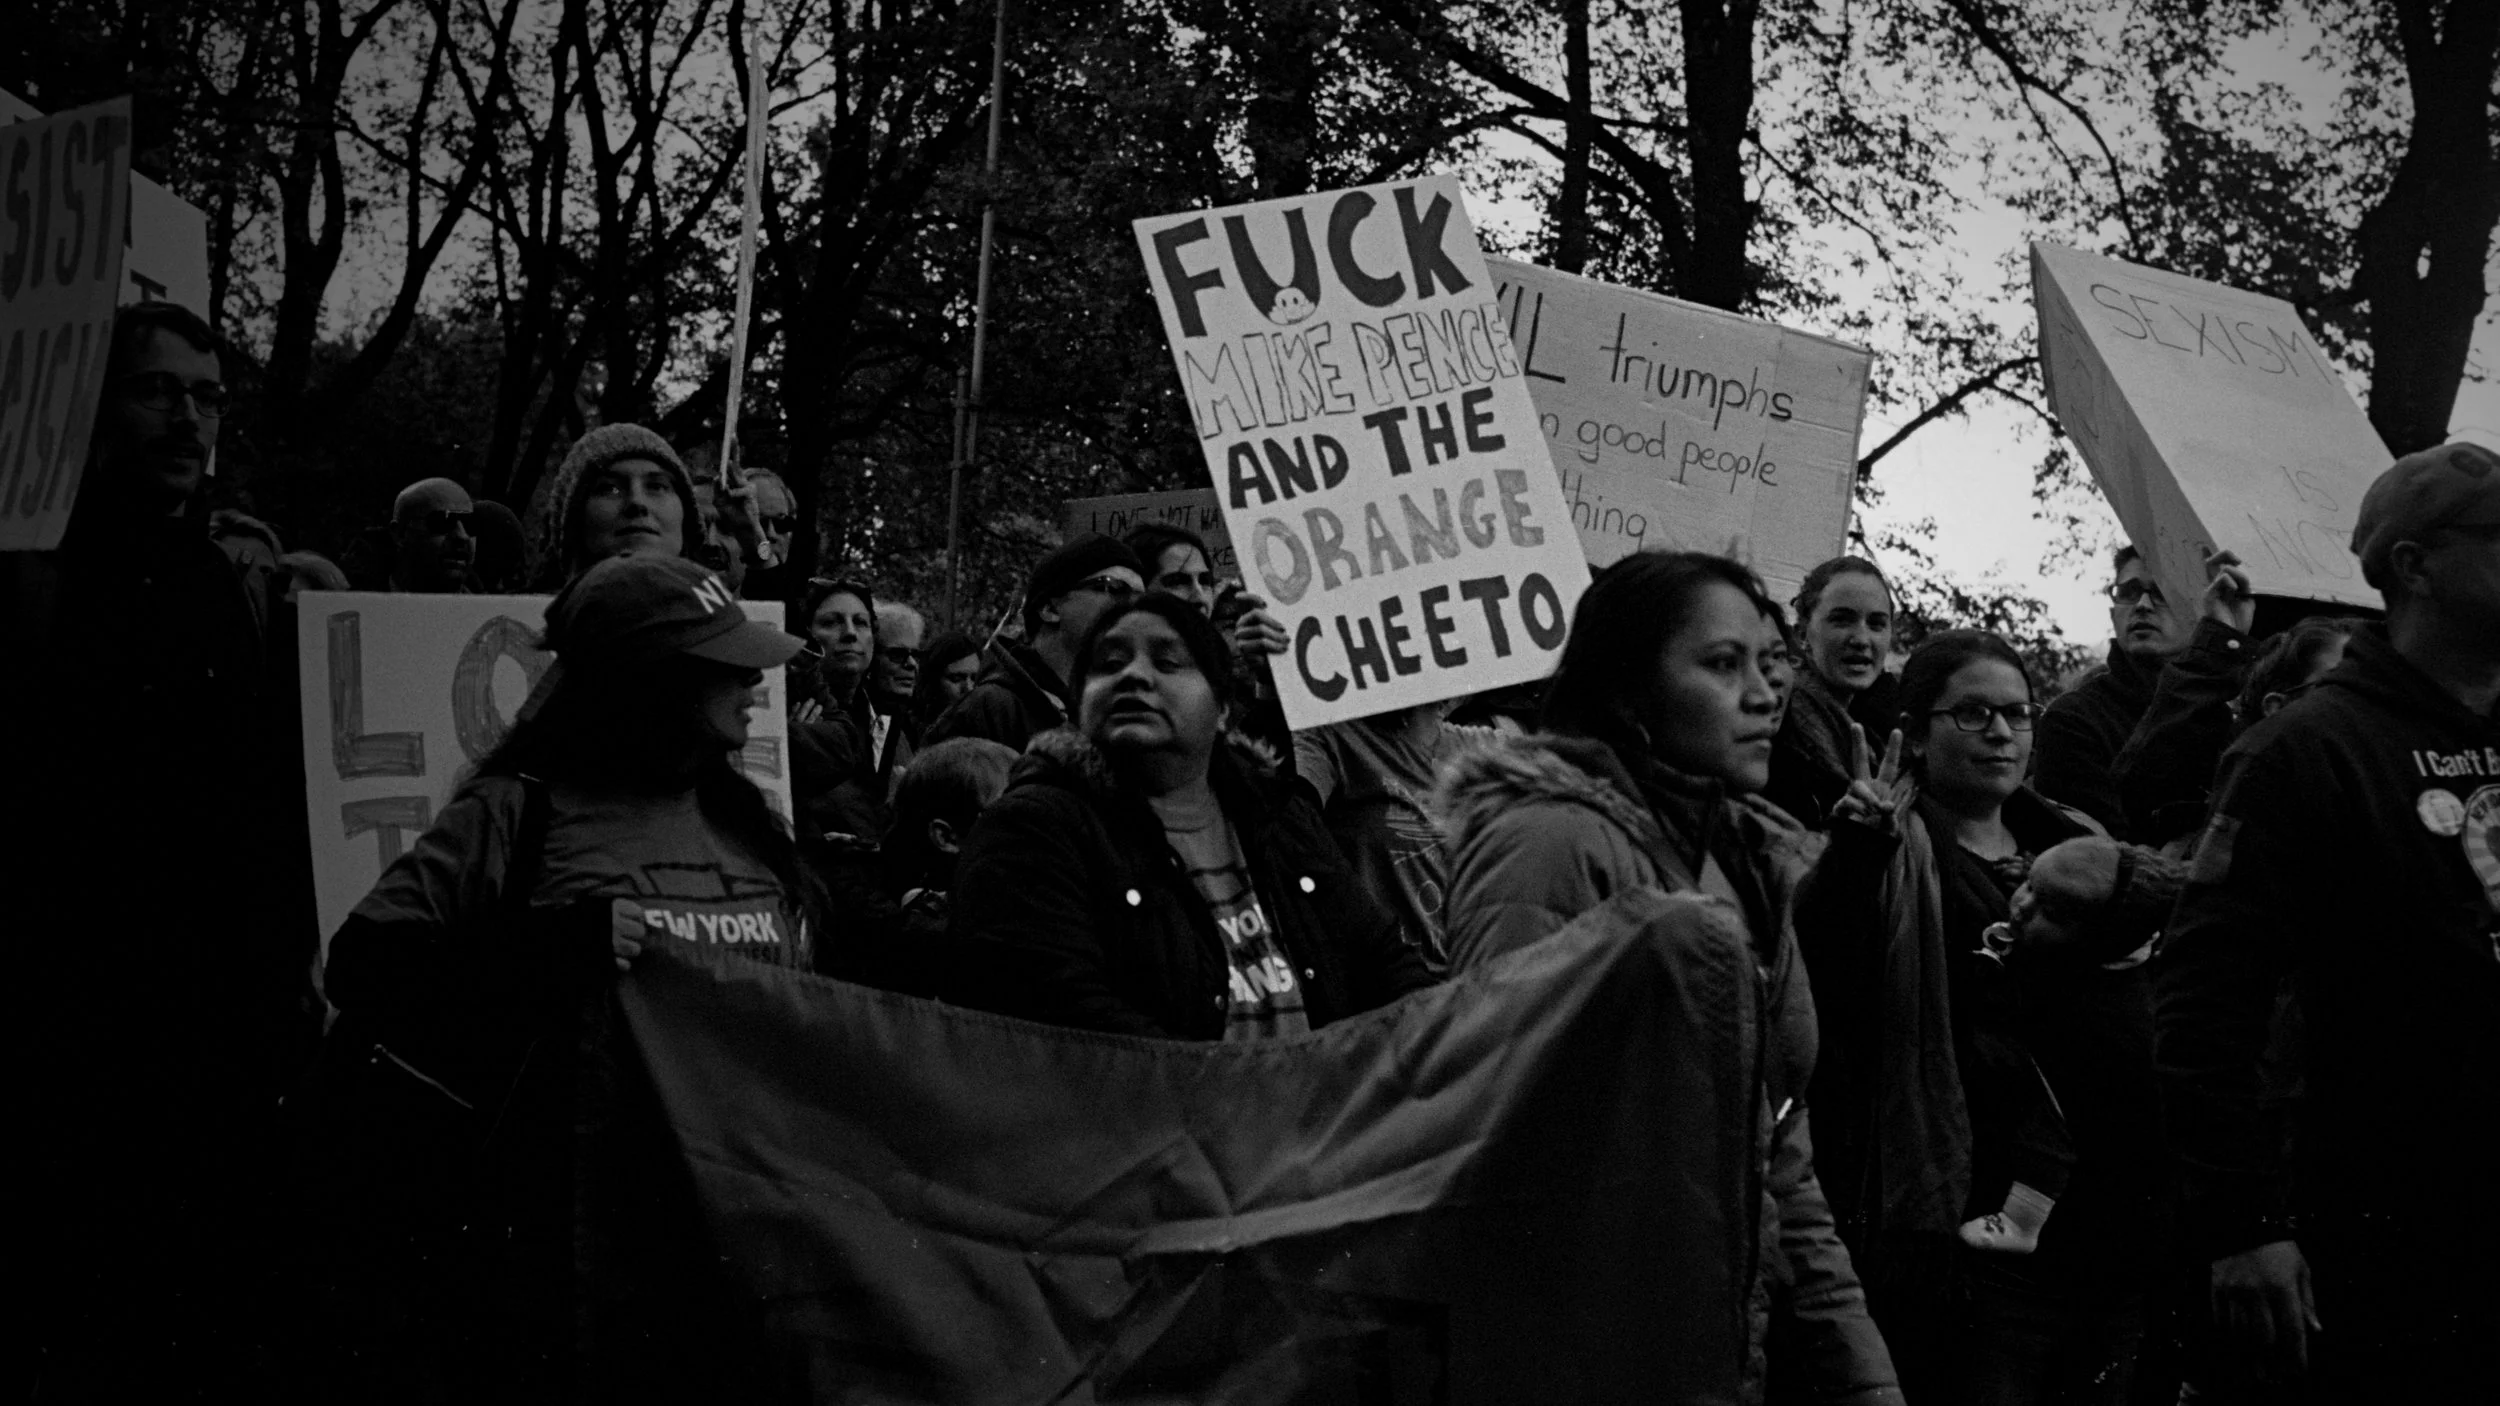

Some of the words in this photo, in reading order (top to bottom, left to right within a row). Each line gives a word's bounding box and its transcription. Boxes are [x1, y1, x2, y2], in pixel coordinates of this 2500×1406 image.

[1153, 186, 1474, 337] FUCK
[1185, 323, 1354, 439] MIKE
[1352, 303, 1519, 404] PENCE
[1497, 282, 1565, 383] IL
[1600, 313, 1794, 430] triumphs
[2090, 284, 2332, 384] SEXISM
[1228, 434, 1349, 508] AND
[1363, 387, 1505, 476] THE
[1578, 421, 1666, 464] good
[1670, 443, 1778, 494] people
[2279, 465, 2339, 512] IS
[1201, 507, 1225, 530] HA
[1213, 546, 1233, 566] KE
[1252, 470, 1544, 605] ORANGE
[1296, 573, 1566, 702] CHEETO
[2412, 749, 2428, 778] I
[2426, 748, 2485, 778] Can't
[644, 908, 697, 942] EW
[697, 911, 780, 944] YORK
[1217, 903, 1271, 944] YO
